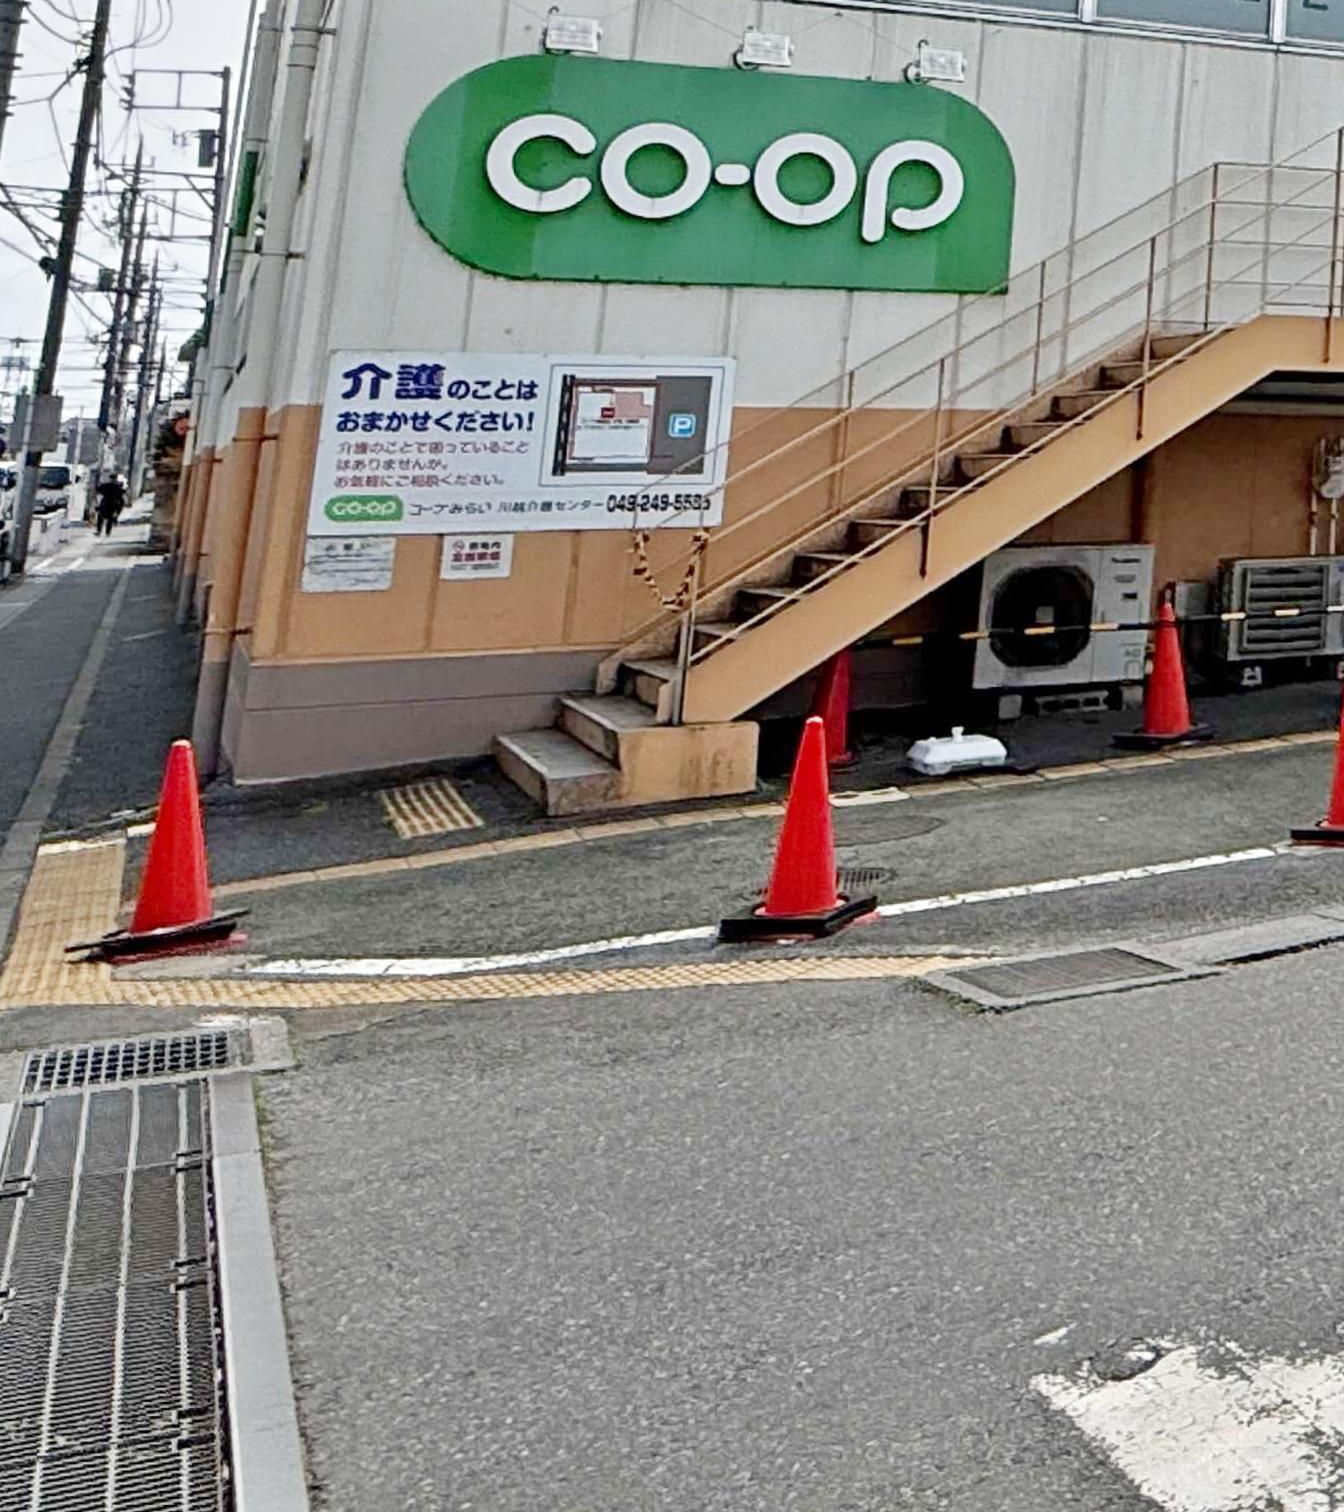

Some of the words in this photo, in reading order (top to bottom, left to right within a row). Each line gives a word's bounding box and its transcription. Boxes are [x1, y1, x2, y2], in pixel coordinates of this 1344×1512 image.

[341, 362, 539, 400] 介護のことは
